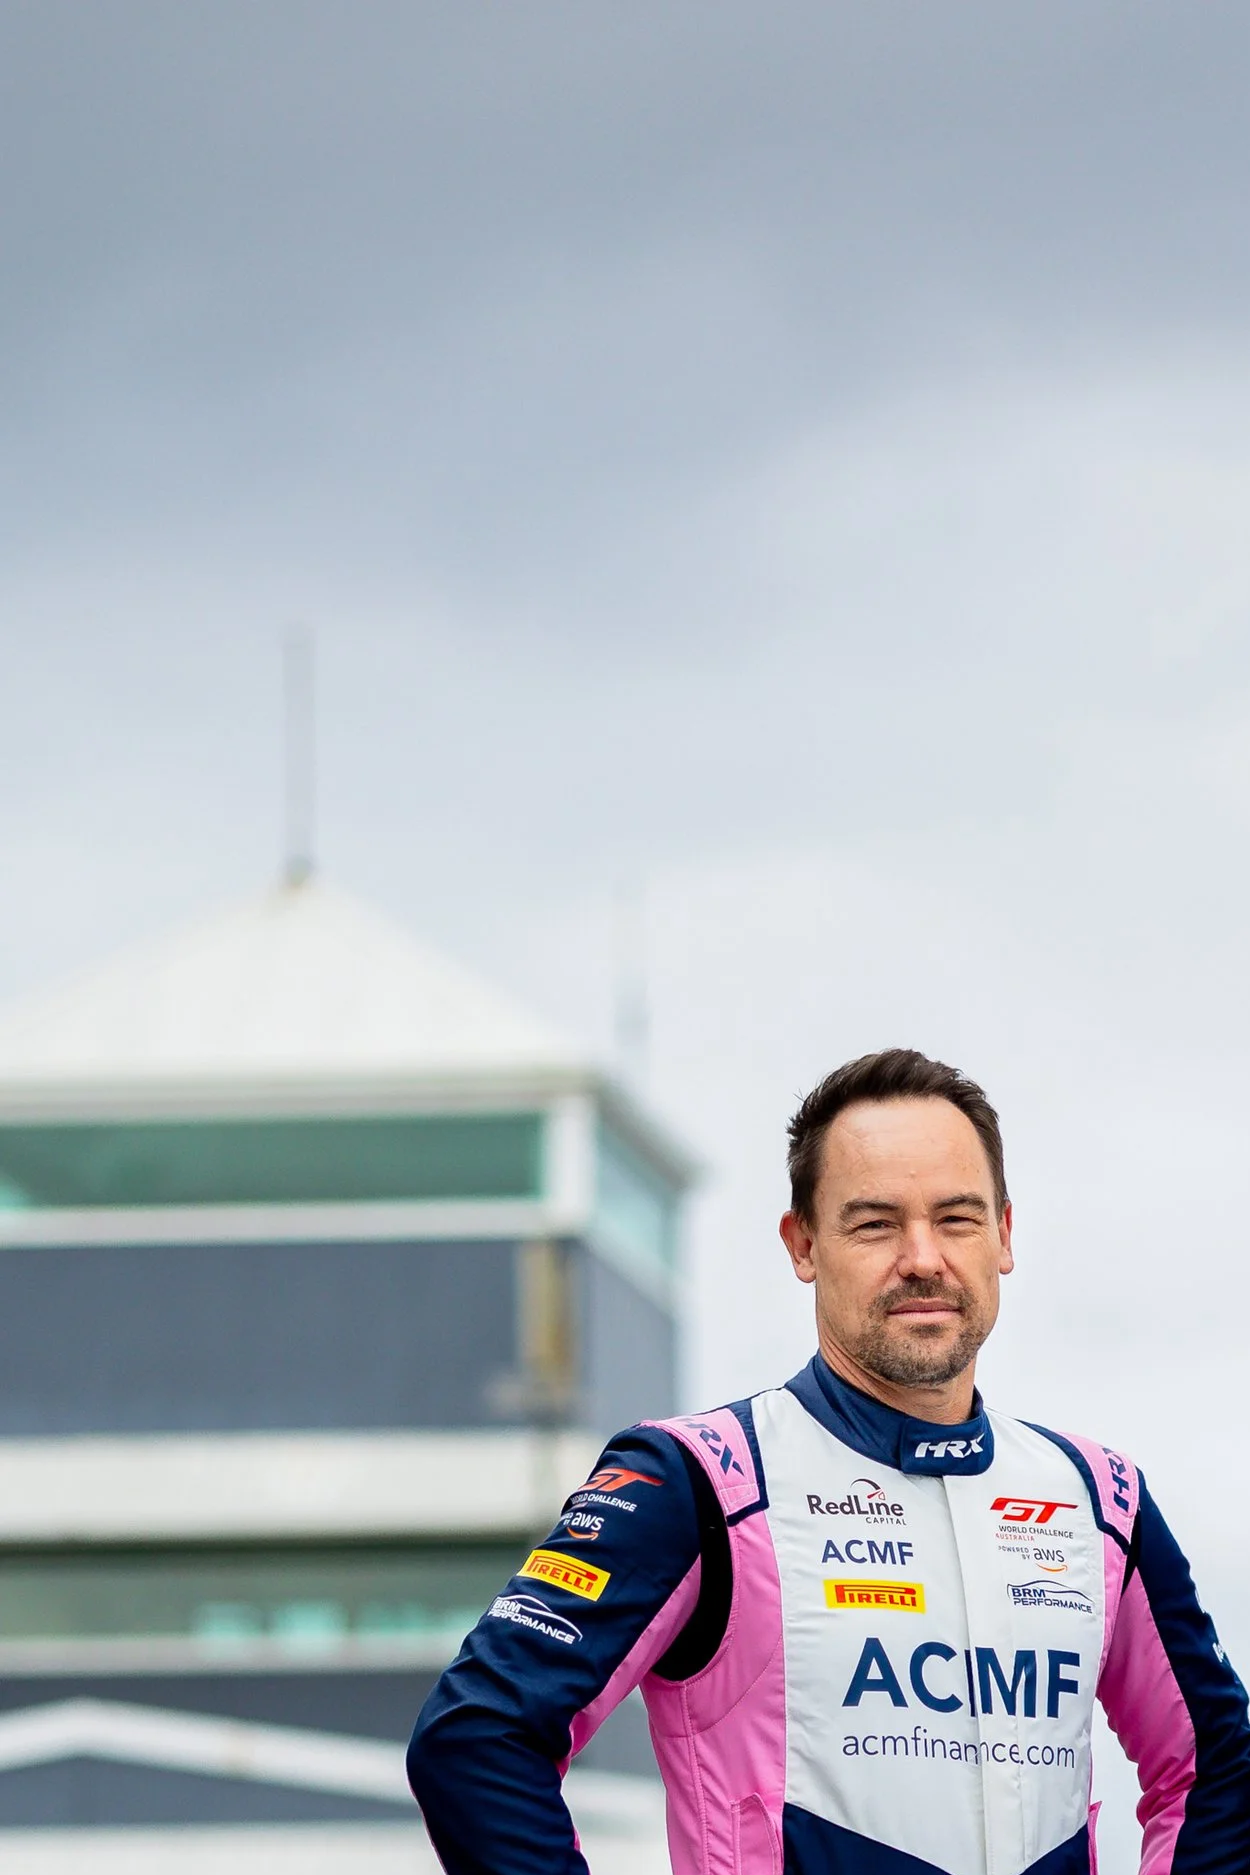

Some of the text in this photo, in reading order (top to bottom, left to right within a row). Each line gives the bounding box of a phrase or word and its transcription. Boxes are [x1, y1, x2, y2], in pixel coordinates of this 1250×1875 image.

[915, 1433, 986, 1459] HRX
[587, 1493, 638, 1512] CHALLENGE
[806, 1494, 904, 1517] RedLine
[571, 1512, 605, 1531] aws
[865, 1516, 907, 1526] CAPITAL
[995, 1533, 1035, 1542] AUSTRALIA
[998, 1525, 1074, 1539] WORLD CHALLENGE
[821, 1539, 914, 1566] ACMF
[1033, 1548, 1065, 1563] aws
[526, 1555, 599, 1593] PIRELLI
[834, 1584, 917, 1607] PIRELLI
[1011, 1588, 1046, 1598] BRM
[493, 1599, 522, 1613] BRM
[1013, 1598, 1093, 1614] PERFORMANCE
[487, 1608, 576, 1644] PERFORMANCE
[841, 1637, 1081, 1720] ACMF
[842, 1725, 1076, 1769] acmfinance.com
